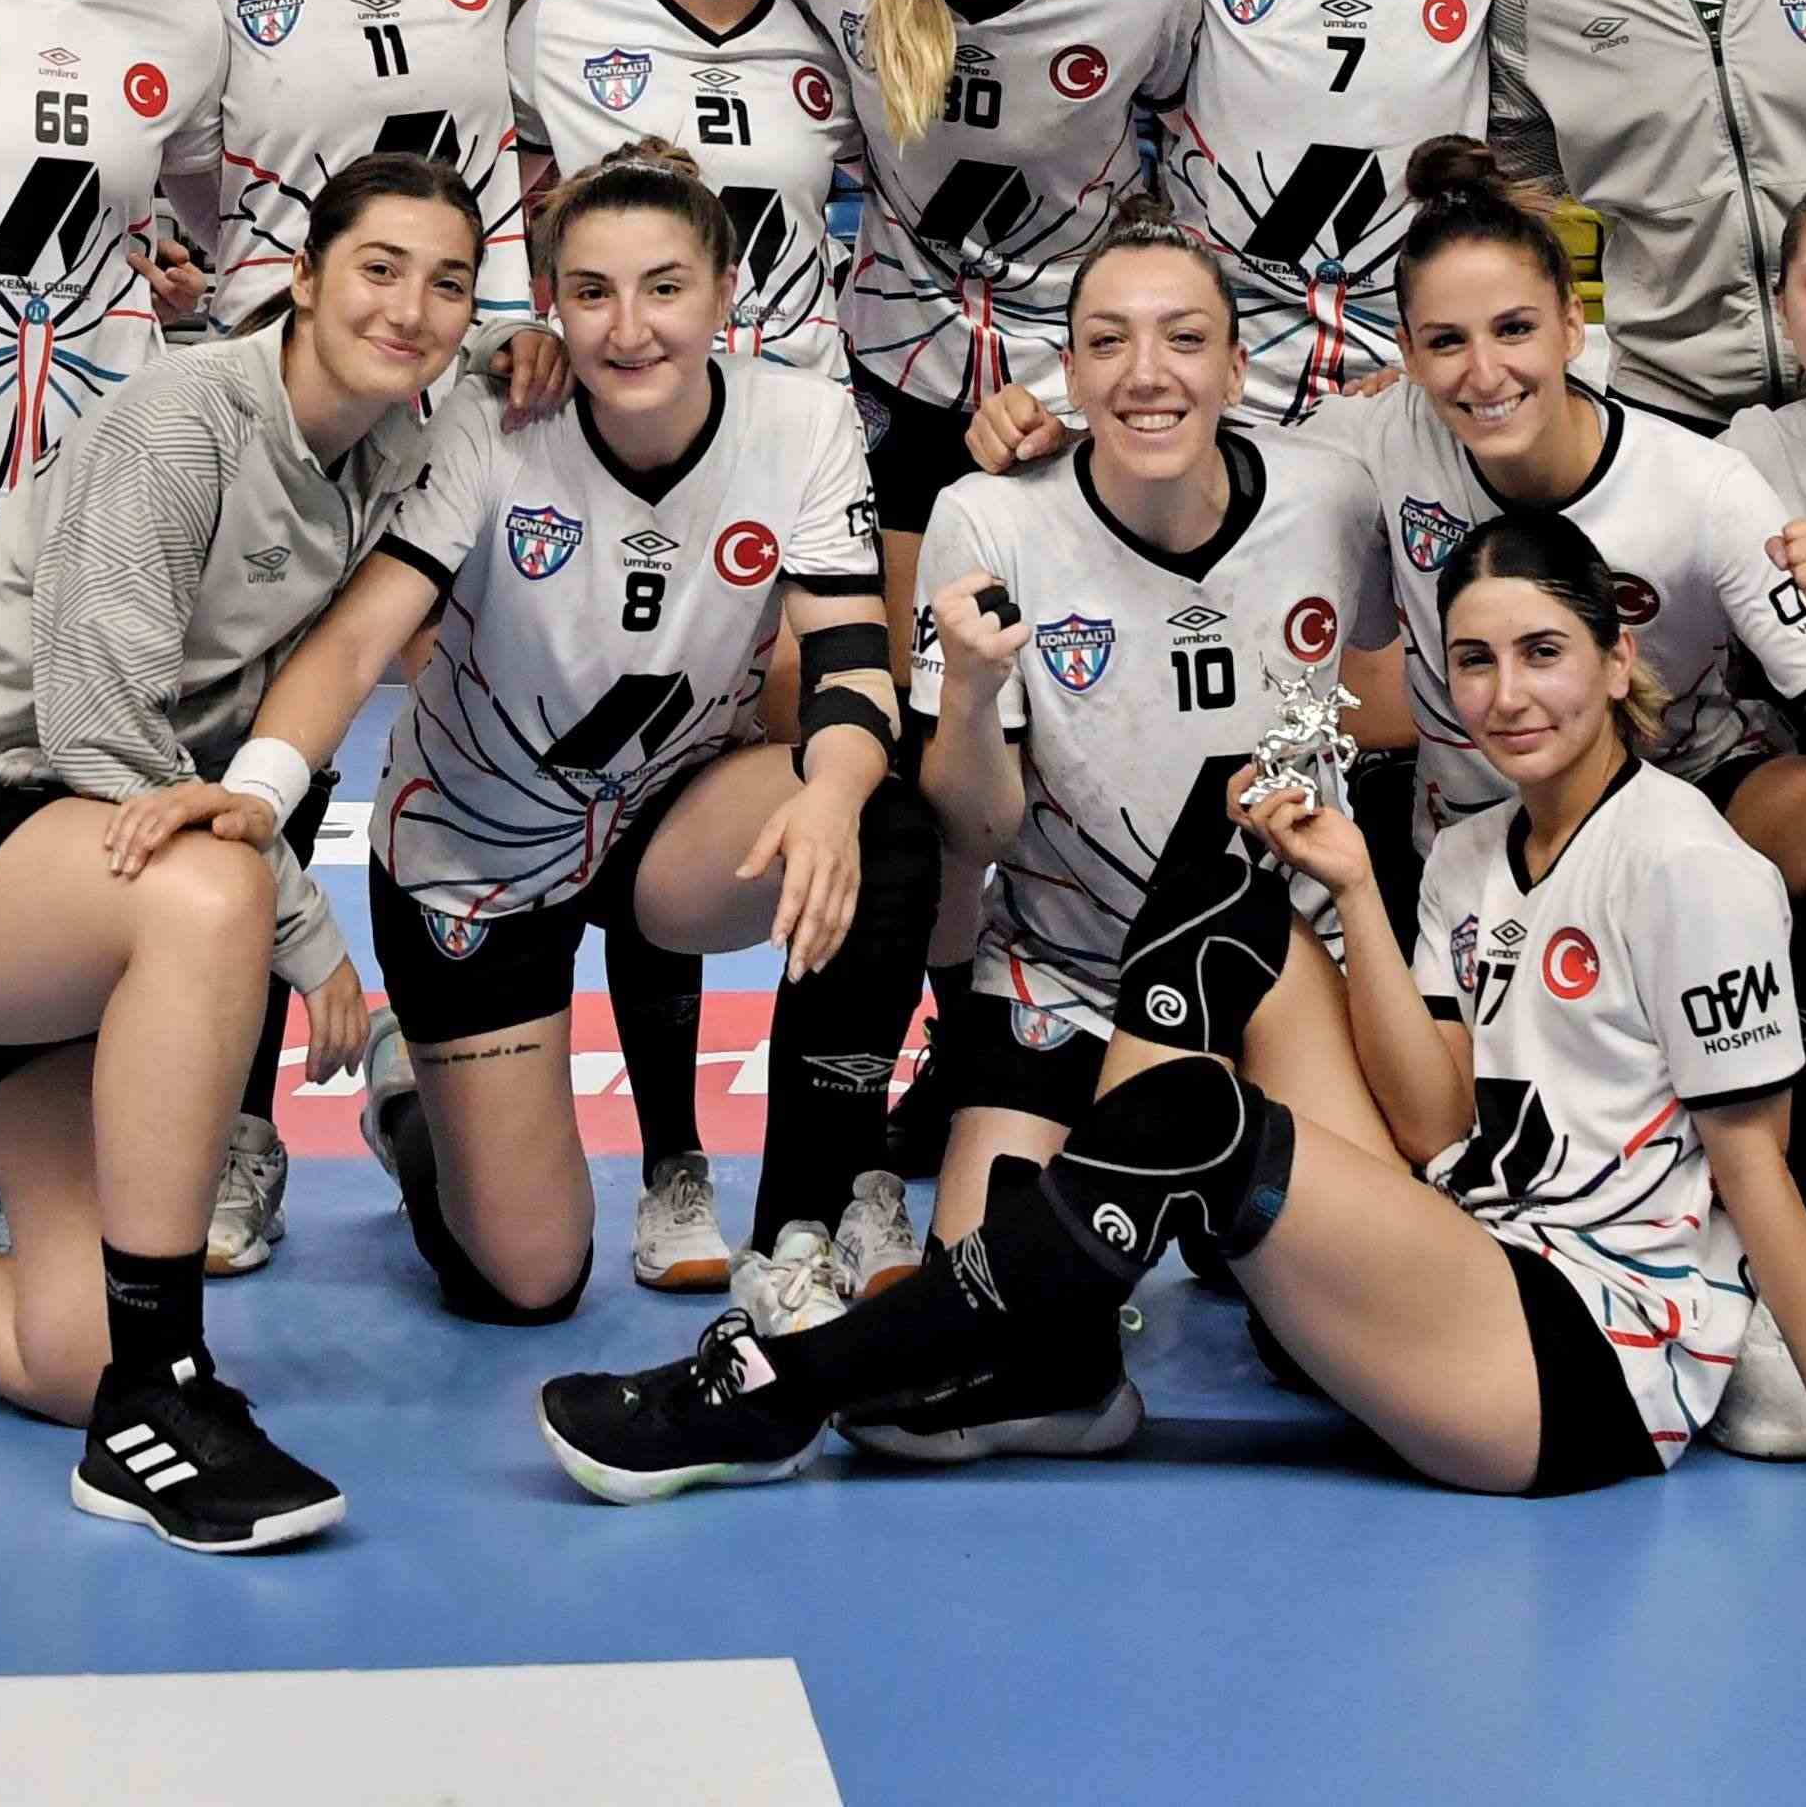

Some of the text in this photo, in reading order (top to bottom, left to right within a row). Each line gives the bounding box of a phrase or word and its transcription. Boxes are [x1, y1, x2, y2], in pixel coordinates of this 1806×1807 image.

[357, 11, 400, 20] umbro
[1323, 17, 1367, 30] umbro
[363, 24, 409, 77] 11
[1590, 35, 1630, 54] umbro
[38, 67, 79, 80] umbro
[587, 61, 650, 77] KONYAALTI
[953, 63, 990, 76] mbro
[1327, 36, 1366, 93] 7
[35, 90, 89, 146] 66
[695, 96, 752, 146] 21
[509, 516, 580, 543] KONYAALTI
[623, 556, 672, 571] umbro
[622, 572, 666, 632] 8
[1040, 629, 1113, 647] KONYAALTI
[1172, 631, 1222, 645] umbro
[1171, 646, 1236, 712] 10
[1474, 960, 1516, 1026] 17
[1703, 1022, 1782, 1055] HOSPITAL
